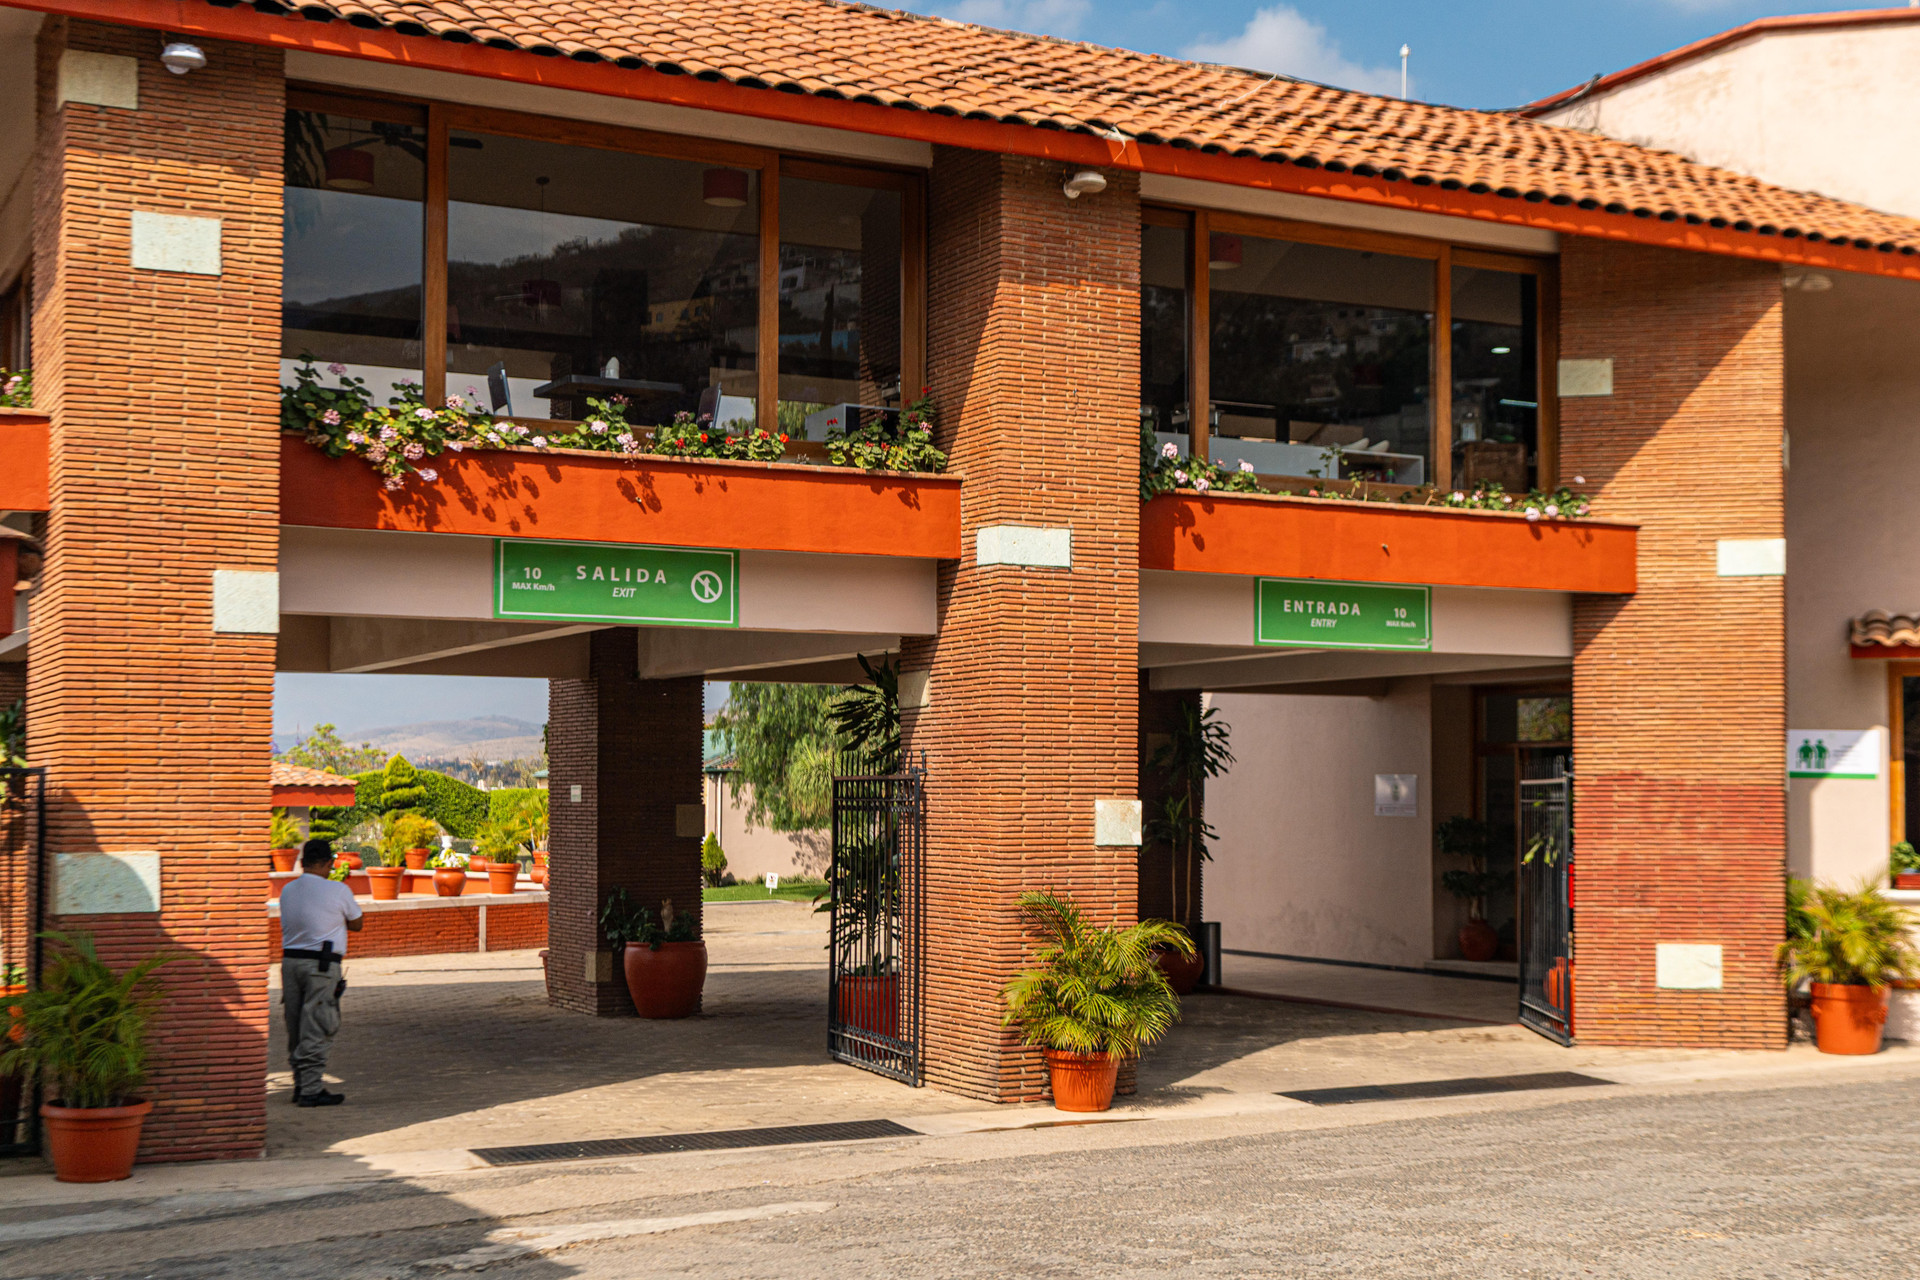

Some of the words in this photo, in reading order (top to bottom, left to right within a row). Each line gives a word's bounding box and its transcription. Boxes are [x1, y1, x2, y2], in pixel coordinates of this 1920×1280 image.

[523, 566, 542, 580] 10
[576, 565, 667, 584] SALIDA
[512, 582, 532, 591] MAX
[533, 583, 556, 592] Km/h
[612, 587, 637, 598] EXIT
[1283, 599, 1361, 616] ENTRADA
[1393, 607, 1407, 619] 10
[1310, 617, 1338, 628] ENTRY
